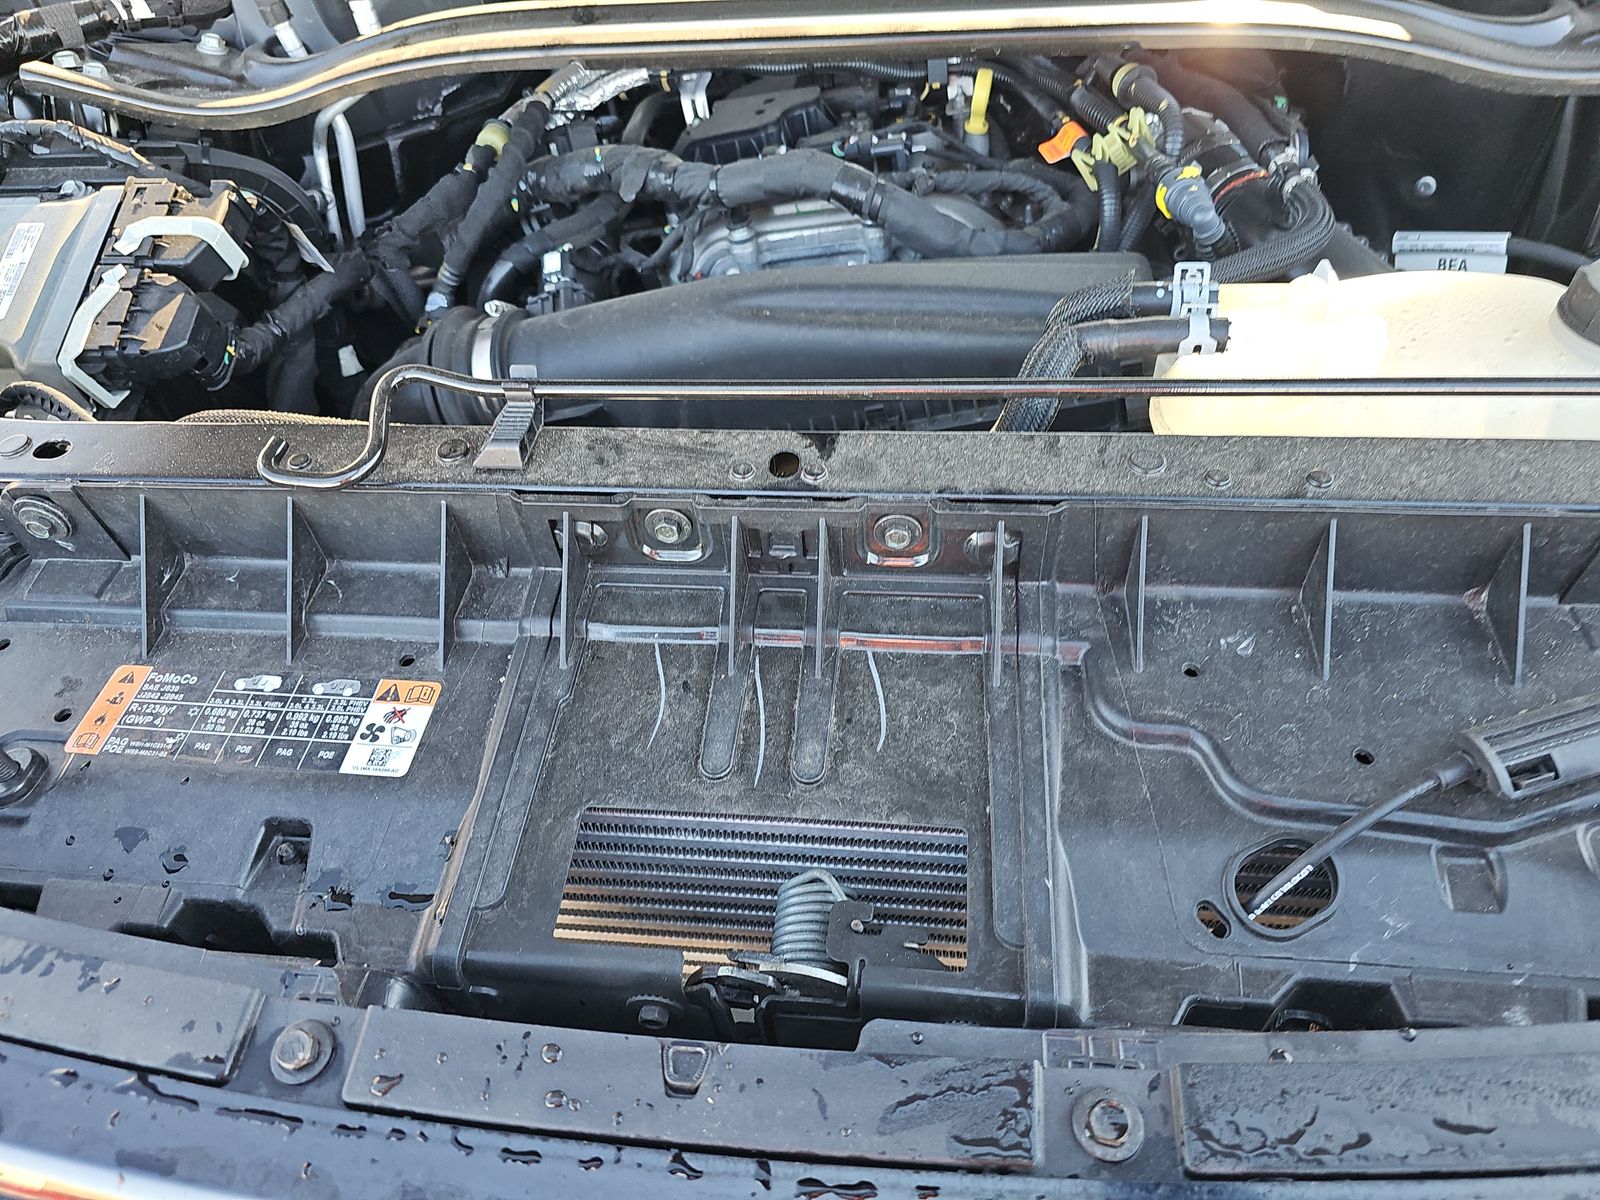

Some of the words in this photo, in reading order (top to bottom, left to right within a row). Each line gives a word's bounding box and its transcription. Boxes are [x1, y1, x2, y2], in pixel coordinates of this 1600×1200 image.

[147, 672, 197, 684] FoMoCo
[142, 683, 159, 691] SAE
[128, 702, 178, 716] R-1234yf
[227, 709, 238, 719] kg
[243, 709, 267, 718] 0.737
[266, 711, 278, 721] kg
[308, 713, 320, 723] kg
[121, 714, 154, 725] (GWP
[155, 716, 166, 727] 4)
[348, 716, 361, 726] kg
[214, 724, 226, 732] lbs
[253, 726, 265, 735] lbs
[296, 729, 309, 737] lbs
[107, 736, 129, 746] PAG
[102, 744, 125, 754] POE
[194, 742, 211, 751] PAG
[234, 745, 252, 754] POE
[275, 747, 293, 756] PAG
[317, 750, 335, 759] POE
